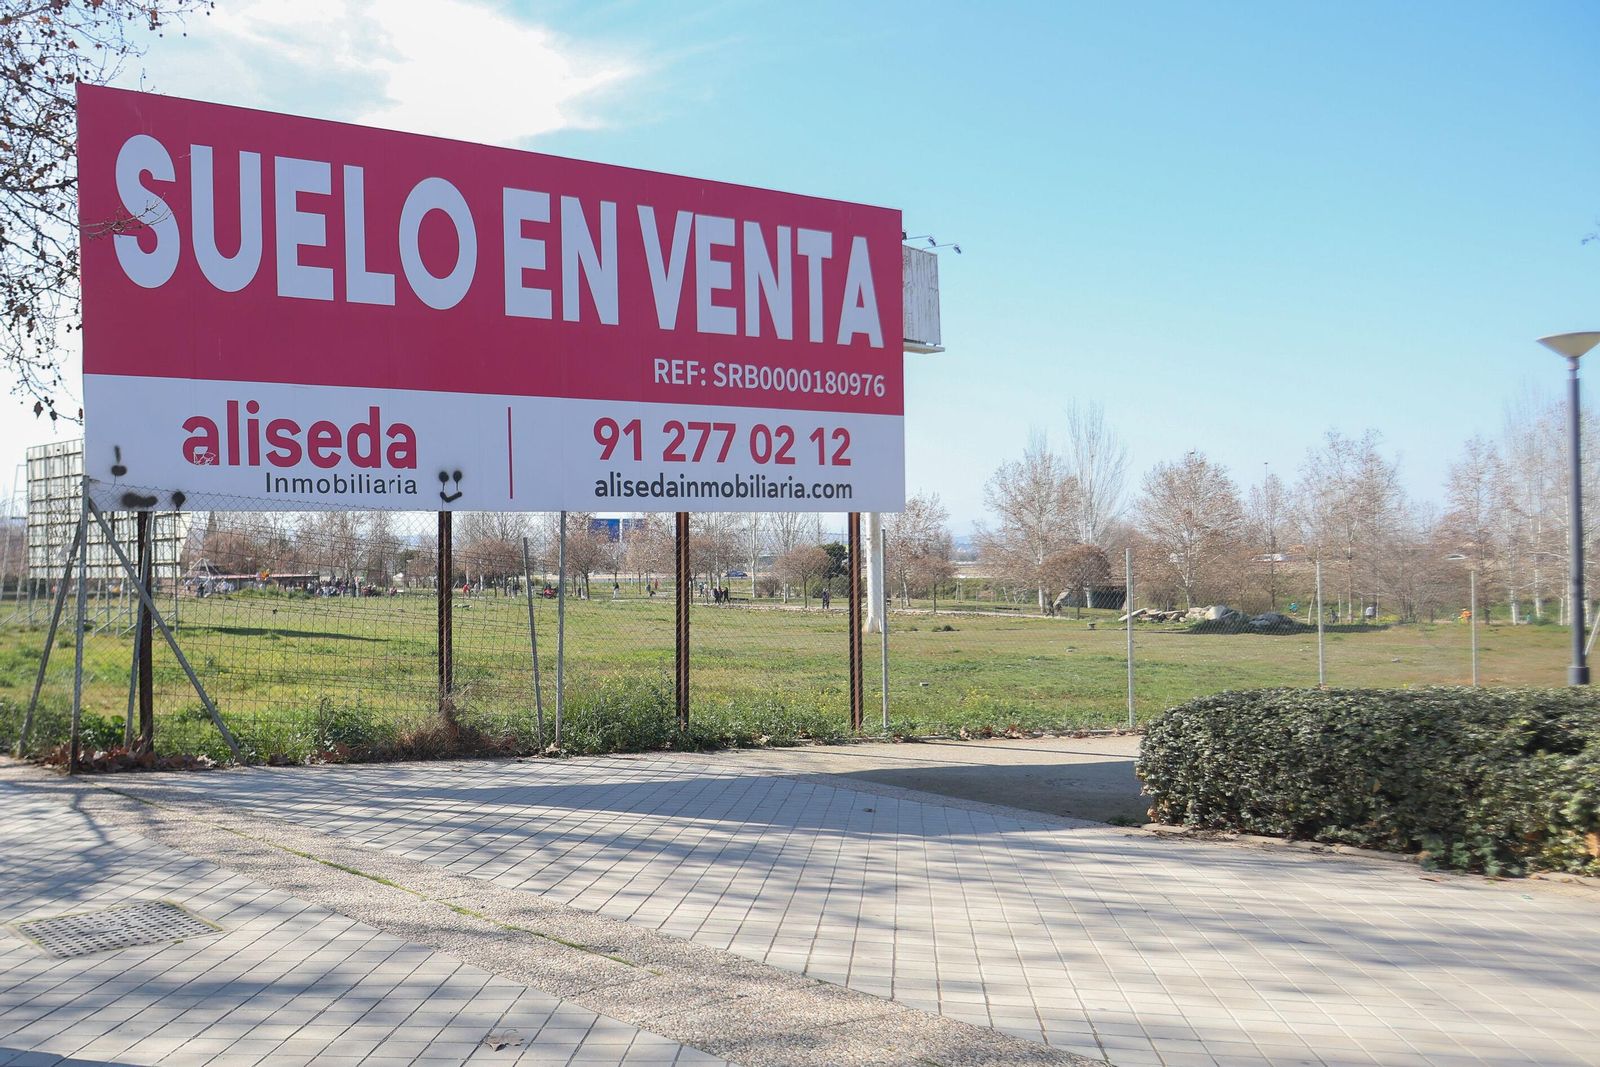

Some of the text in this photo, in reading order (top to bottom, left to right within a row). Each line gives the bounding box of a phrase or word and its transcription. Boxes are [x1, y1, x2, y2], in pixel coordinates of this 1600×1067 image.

[113, 134, 885, 349] SUELO EN VENTA
[653, 358, 886, 398] REF: SRB0000180976
[182, 399, 417, 470] aliseda
[593, 417, 852, 467] 91 277 02 12
[265, 471, 418, 495] Inmobiliaria
[594, 471, 853, 500] alisedainmobiliaria.com
